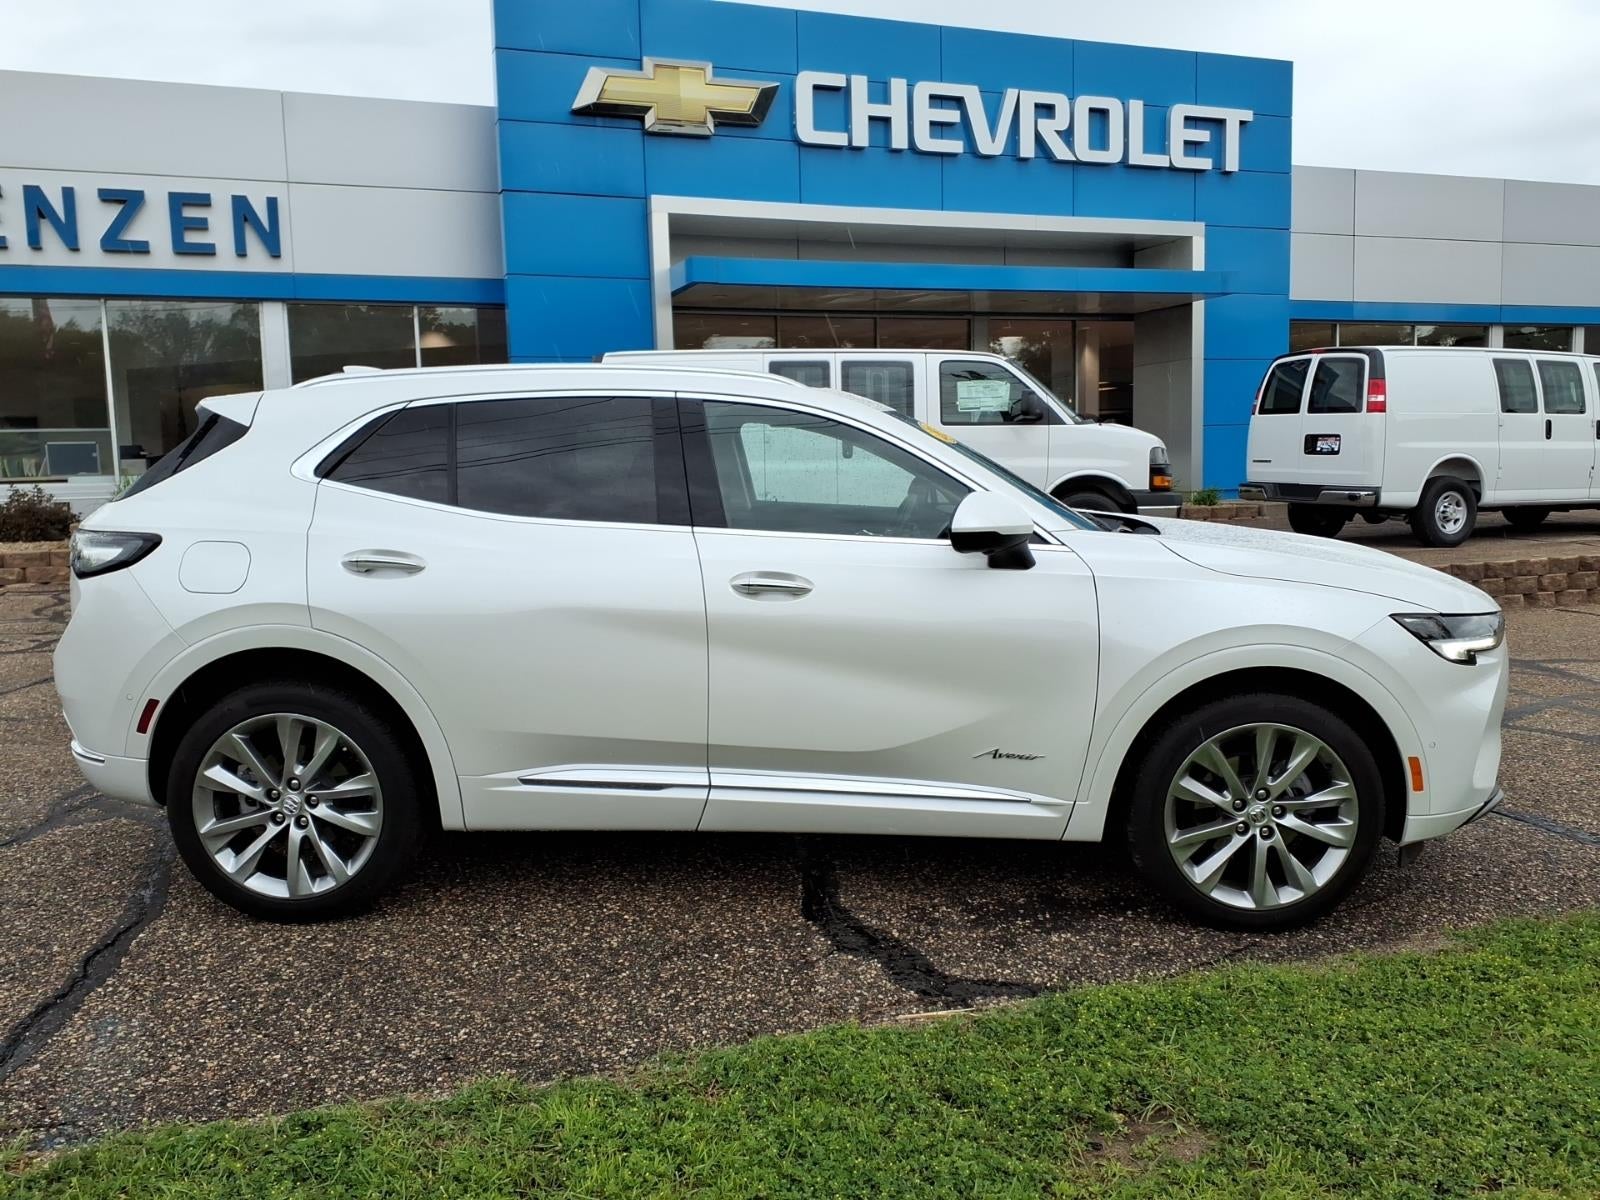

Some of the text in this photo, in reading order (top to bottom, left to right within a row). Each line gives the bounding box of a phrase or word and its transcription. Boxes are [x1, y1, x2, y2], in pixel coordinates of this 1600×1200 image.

[795, 70, 1254, 173] CHEVROLET
[0, 184, 281, 259] NZEN
[972, 747, 1046, 761] Avenir
